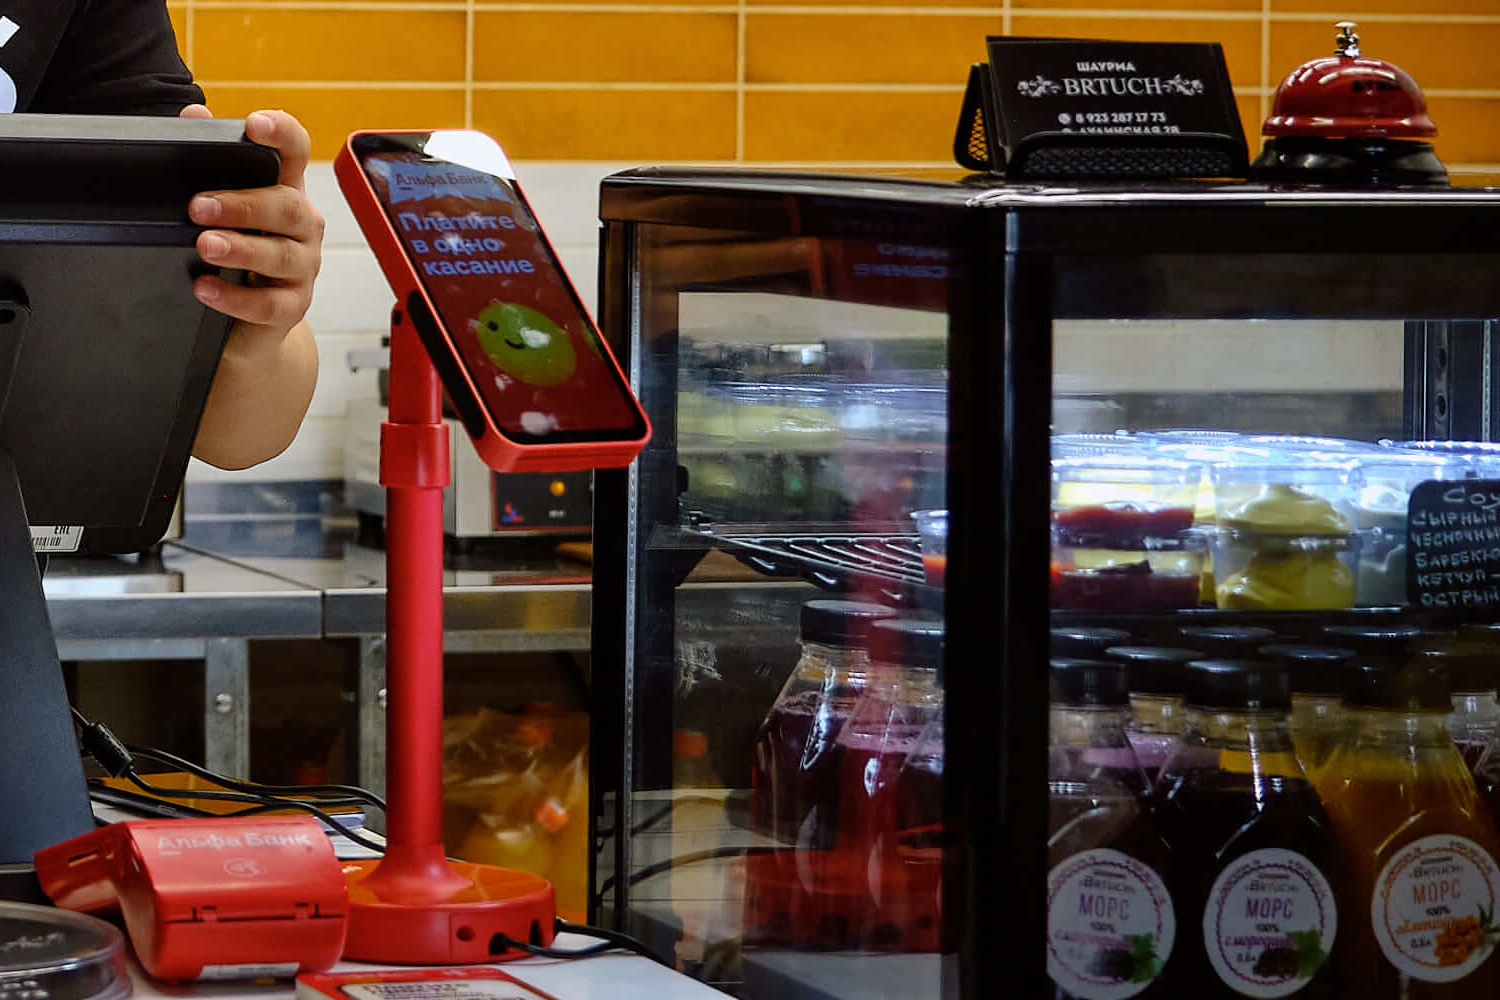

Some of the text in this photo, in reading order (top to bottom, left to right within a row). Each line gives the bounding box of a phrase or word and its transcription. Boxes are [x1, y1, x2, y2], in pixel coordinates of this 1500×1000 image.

[1076, 62, 1137, 72] ШАУРМА
[1061, 77, 1164, 96] BRTUCH
[1086, 113, 1109, 123] 923
[396, 173, 446, 187] Альфа
[398, 212, 516, 232] Платите
[411, 237, 501, 256] в одно
[423, 258, 535, 276] касание
[158, 832, 313, 850] Альфа Банк
[1412, 879, 1461, 905] МОРС
[1079, 893, 1130, 921] МОРС
[1246, 898, 1294, 919] МОРС
